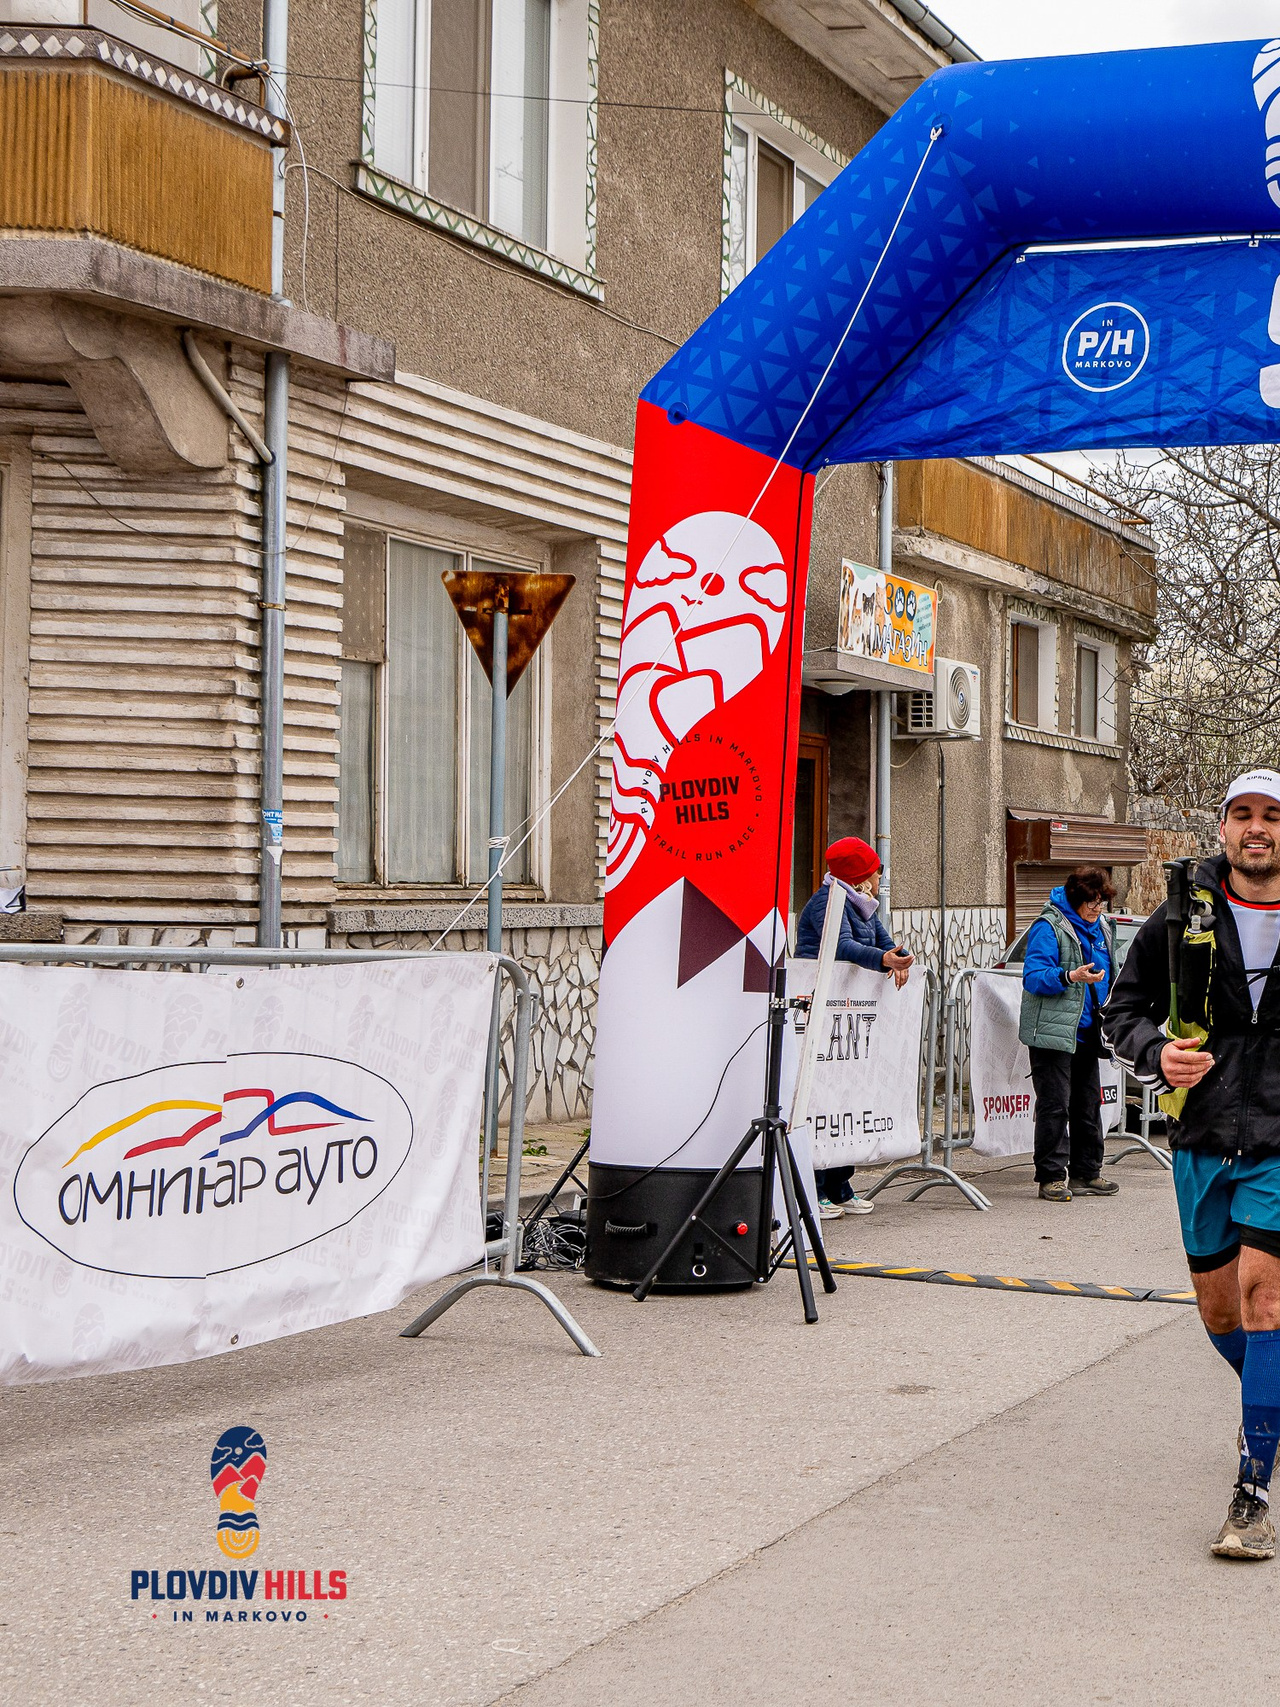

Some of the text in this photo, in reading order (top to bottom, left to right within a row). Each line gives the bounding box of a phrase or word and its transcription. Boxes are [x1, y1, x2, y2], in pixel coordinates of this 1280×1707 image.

[1101, 319, 1114, 327] IN
[1077, 329, 1135, 358] P/H
[1075, 360, 1132, 369] MARKOVO
[873, 622, 929, 666] МАГАЗИН
[641, 733, 763, 814] PLOVDIV HILLS IN MARKOVO
[659, 775, 740, 802] PLOVDIV
[675, 801, 730, 825] HILLS
[653, 826, 755, 861] TRAIL RUN RACE
[983, 1094, 1030, 1122] SPONSER
